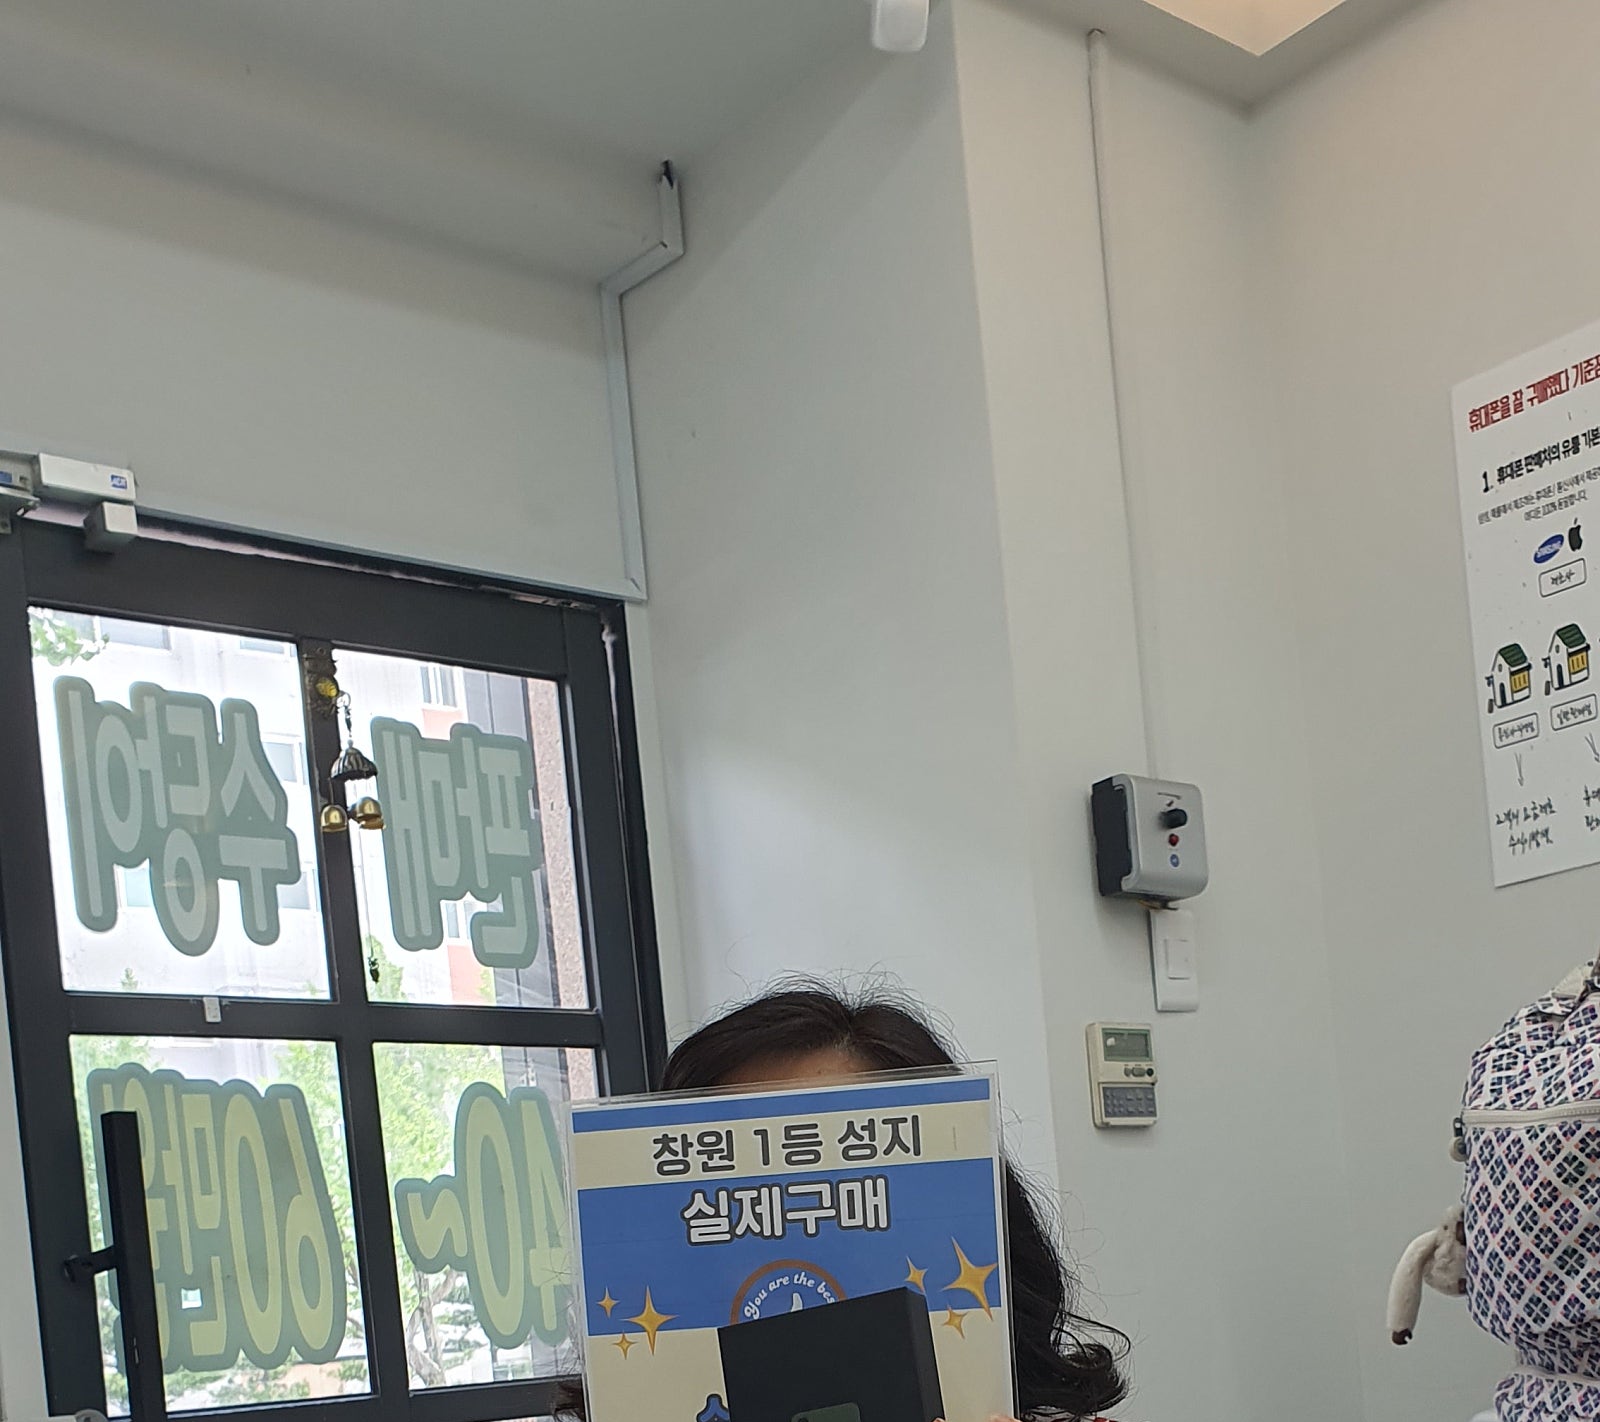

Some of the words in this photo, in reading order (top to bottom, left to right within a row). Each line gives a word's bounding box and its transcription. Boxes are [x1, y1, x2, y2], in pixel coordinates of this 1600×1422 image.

[1468, 394, 1511, 432] 휴대폰을
[1512, 388, 1524, 415] 잘
[652, 1129, 736, 1177] 창원
[753, 1122, 823, 1167] 1등
[837, 1114, 922, 1162] 성지
[680, 1174, 891, 1247] 실제구매
[744, 1288, 768, 1320] You
[768, 1276, 790, 1292] are
[793, 1271, 815, 1287] the
[817, 1281, 836, 1304] bes
